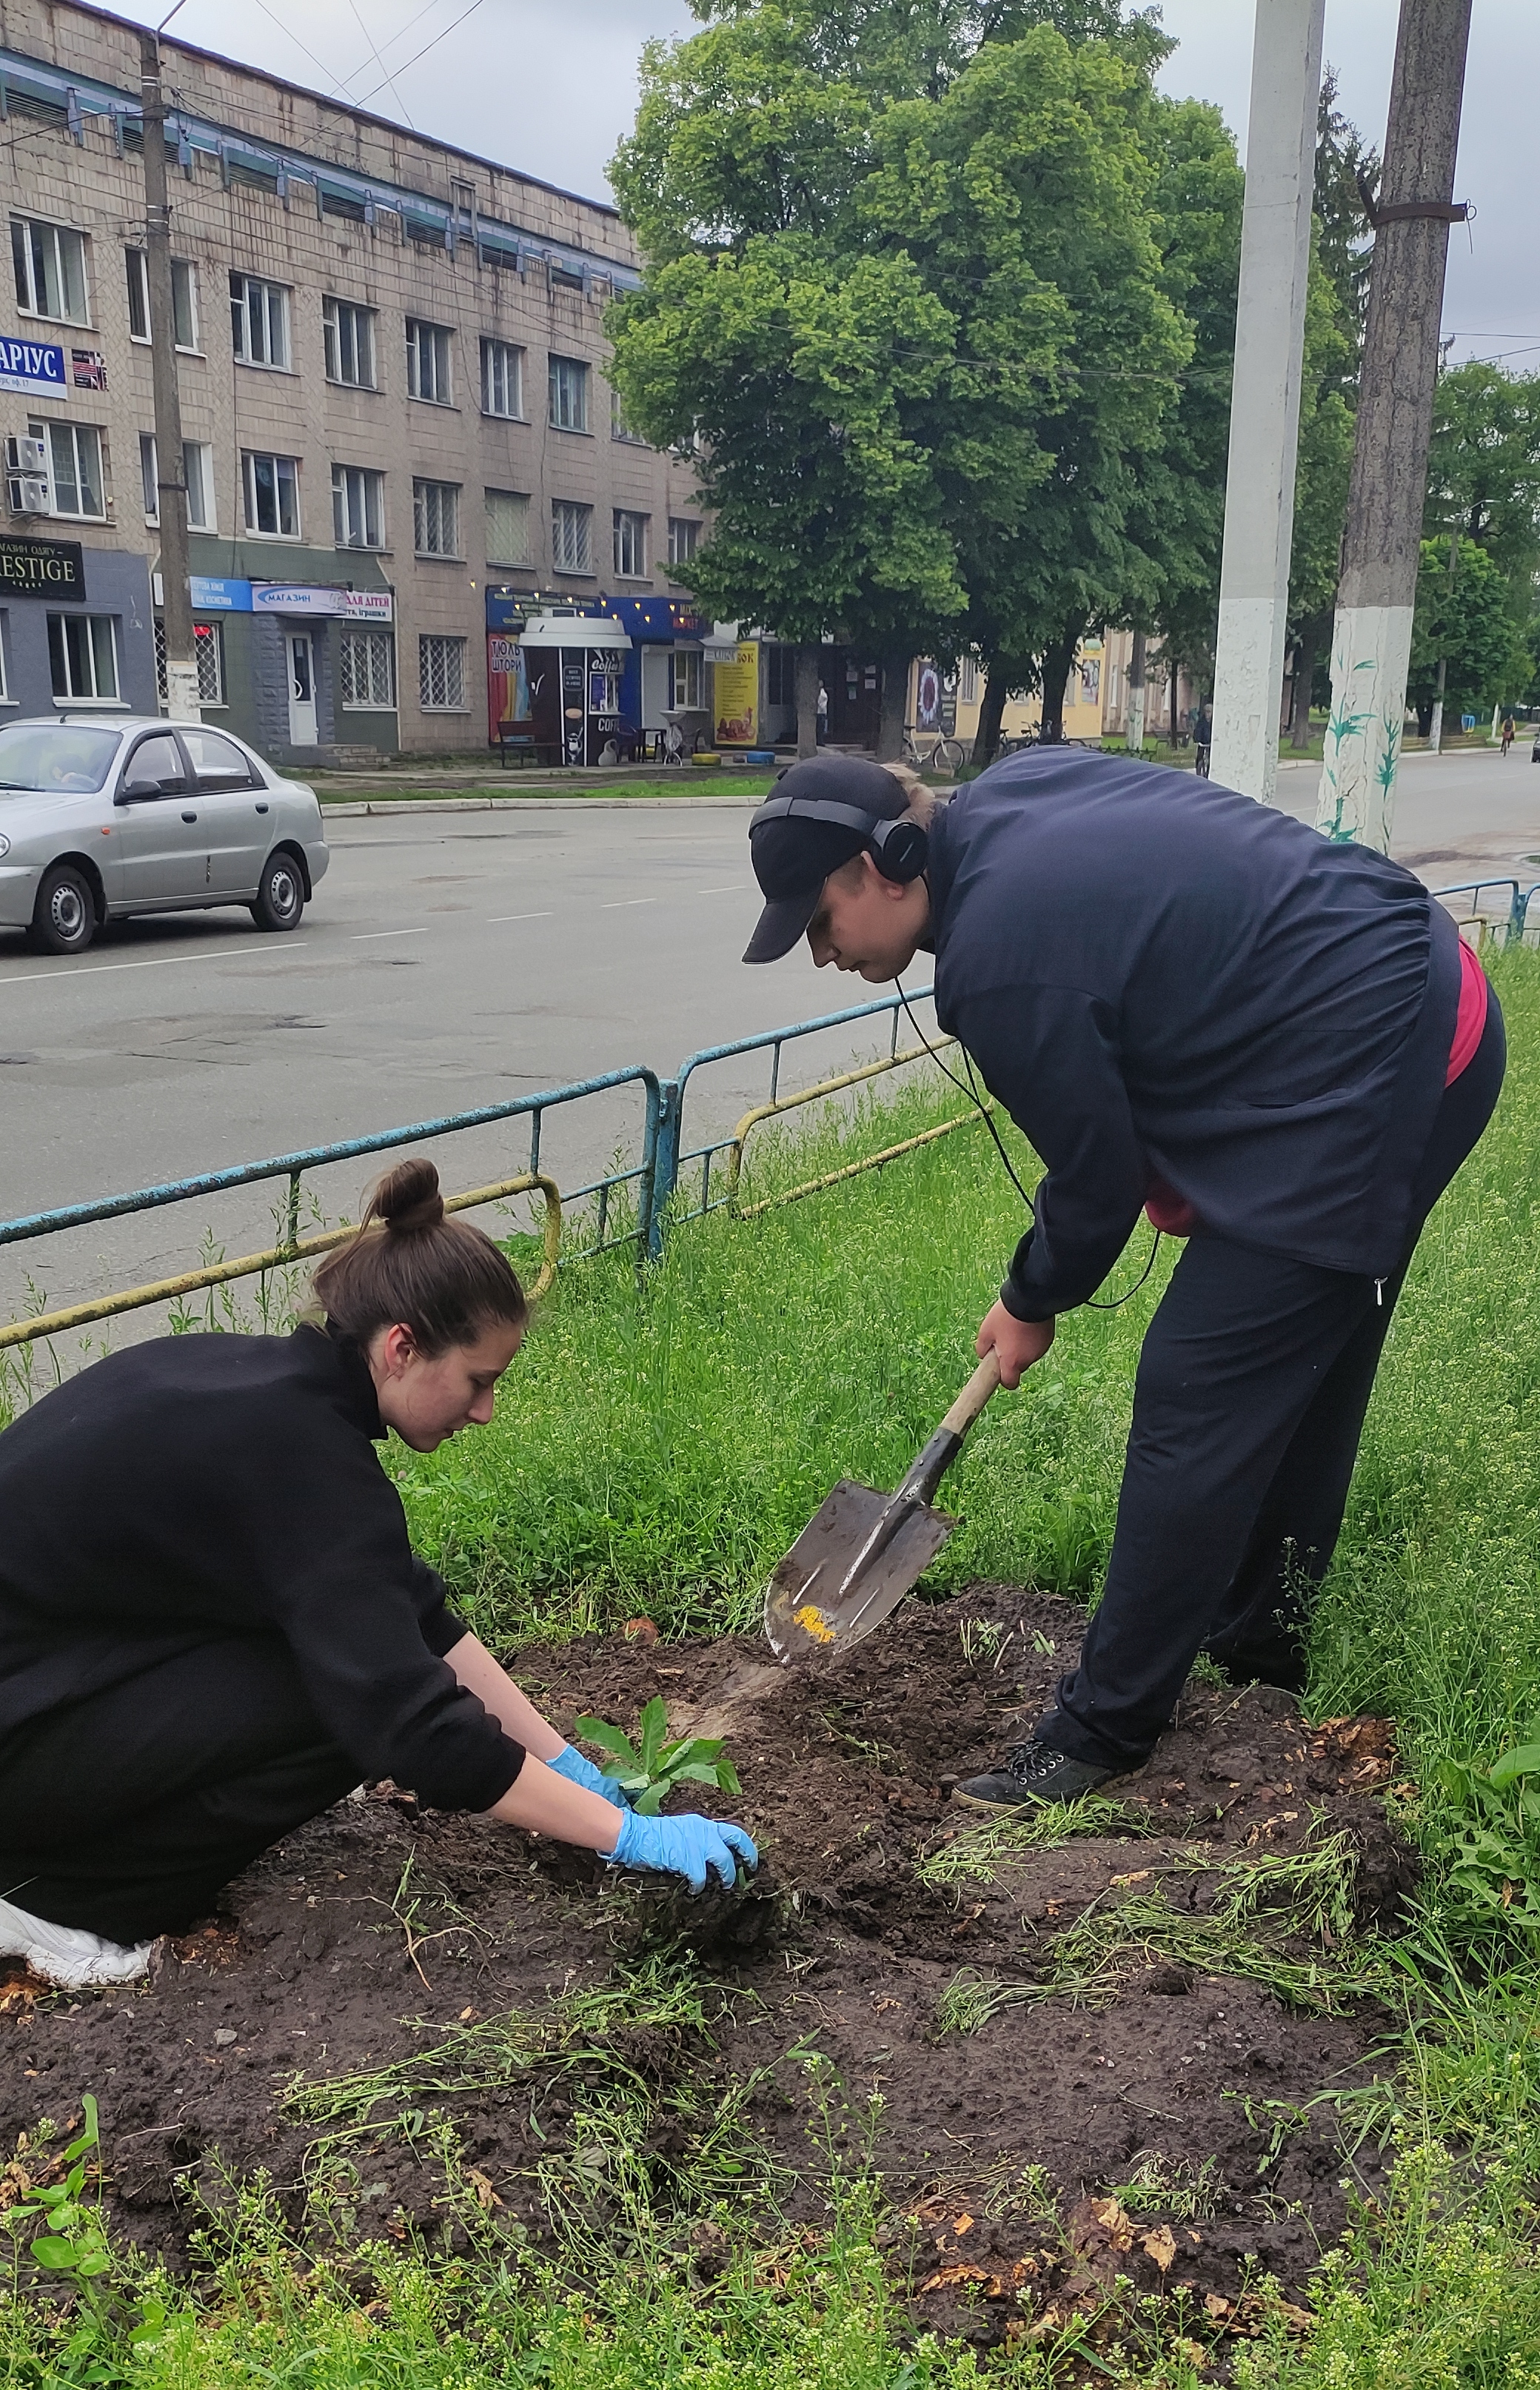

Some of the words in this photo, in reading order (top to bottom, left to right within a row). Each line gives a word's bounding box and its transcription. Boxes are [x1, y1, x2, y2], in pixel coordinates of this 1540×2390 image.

[0, 555, 76, 582] ESTIGE
[268, 594, 311, 603] МАГАЗИН
[366, 595, 389, 608] ДІТЕЙ
[492, 640, 520, 657] ТЮЛЬ
[492, 658, 522, 672] ШТОРИ
